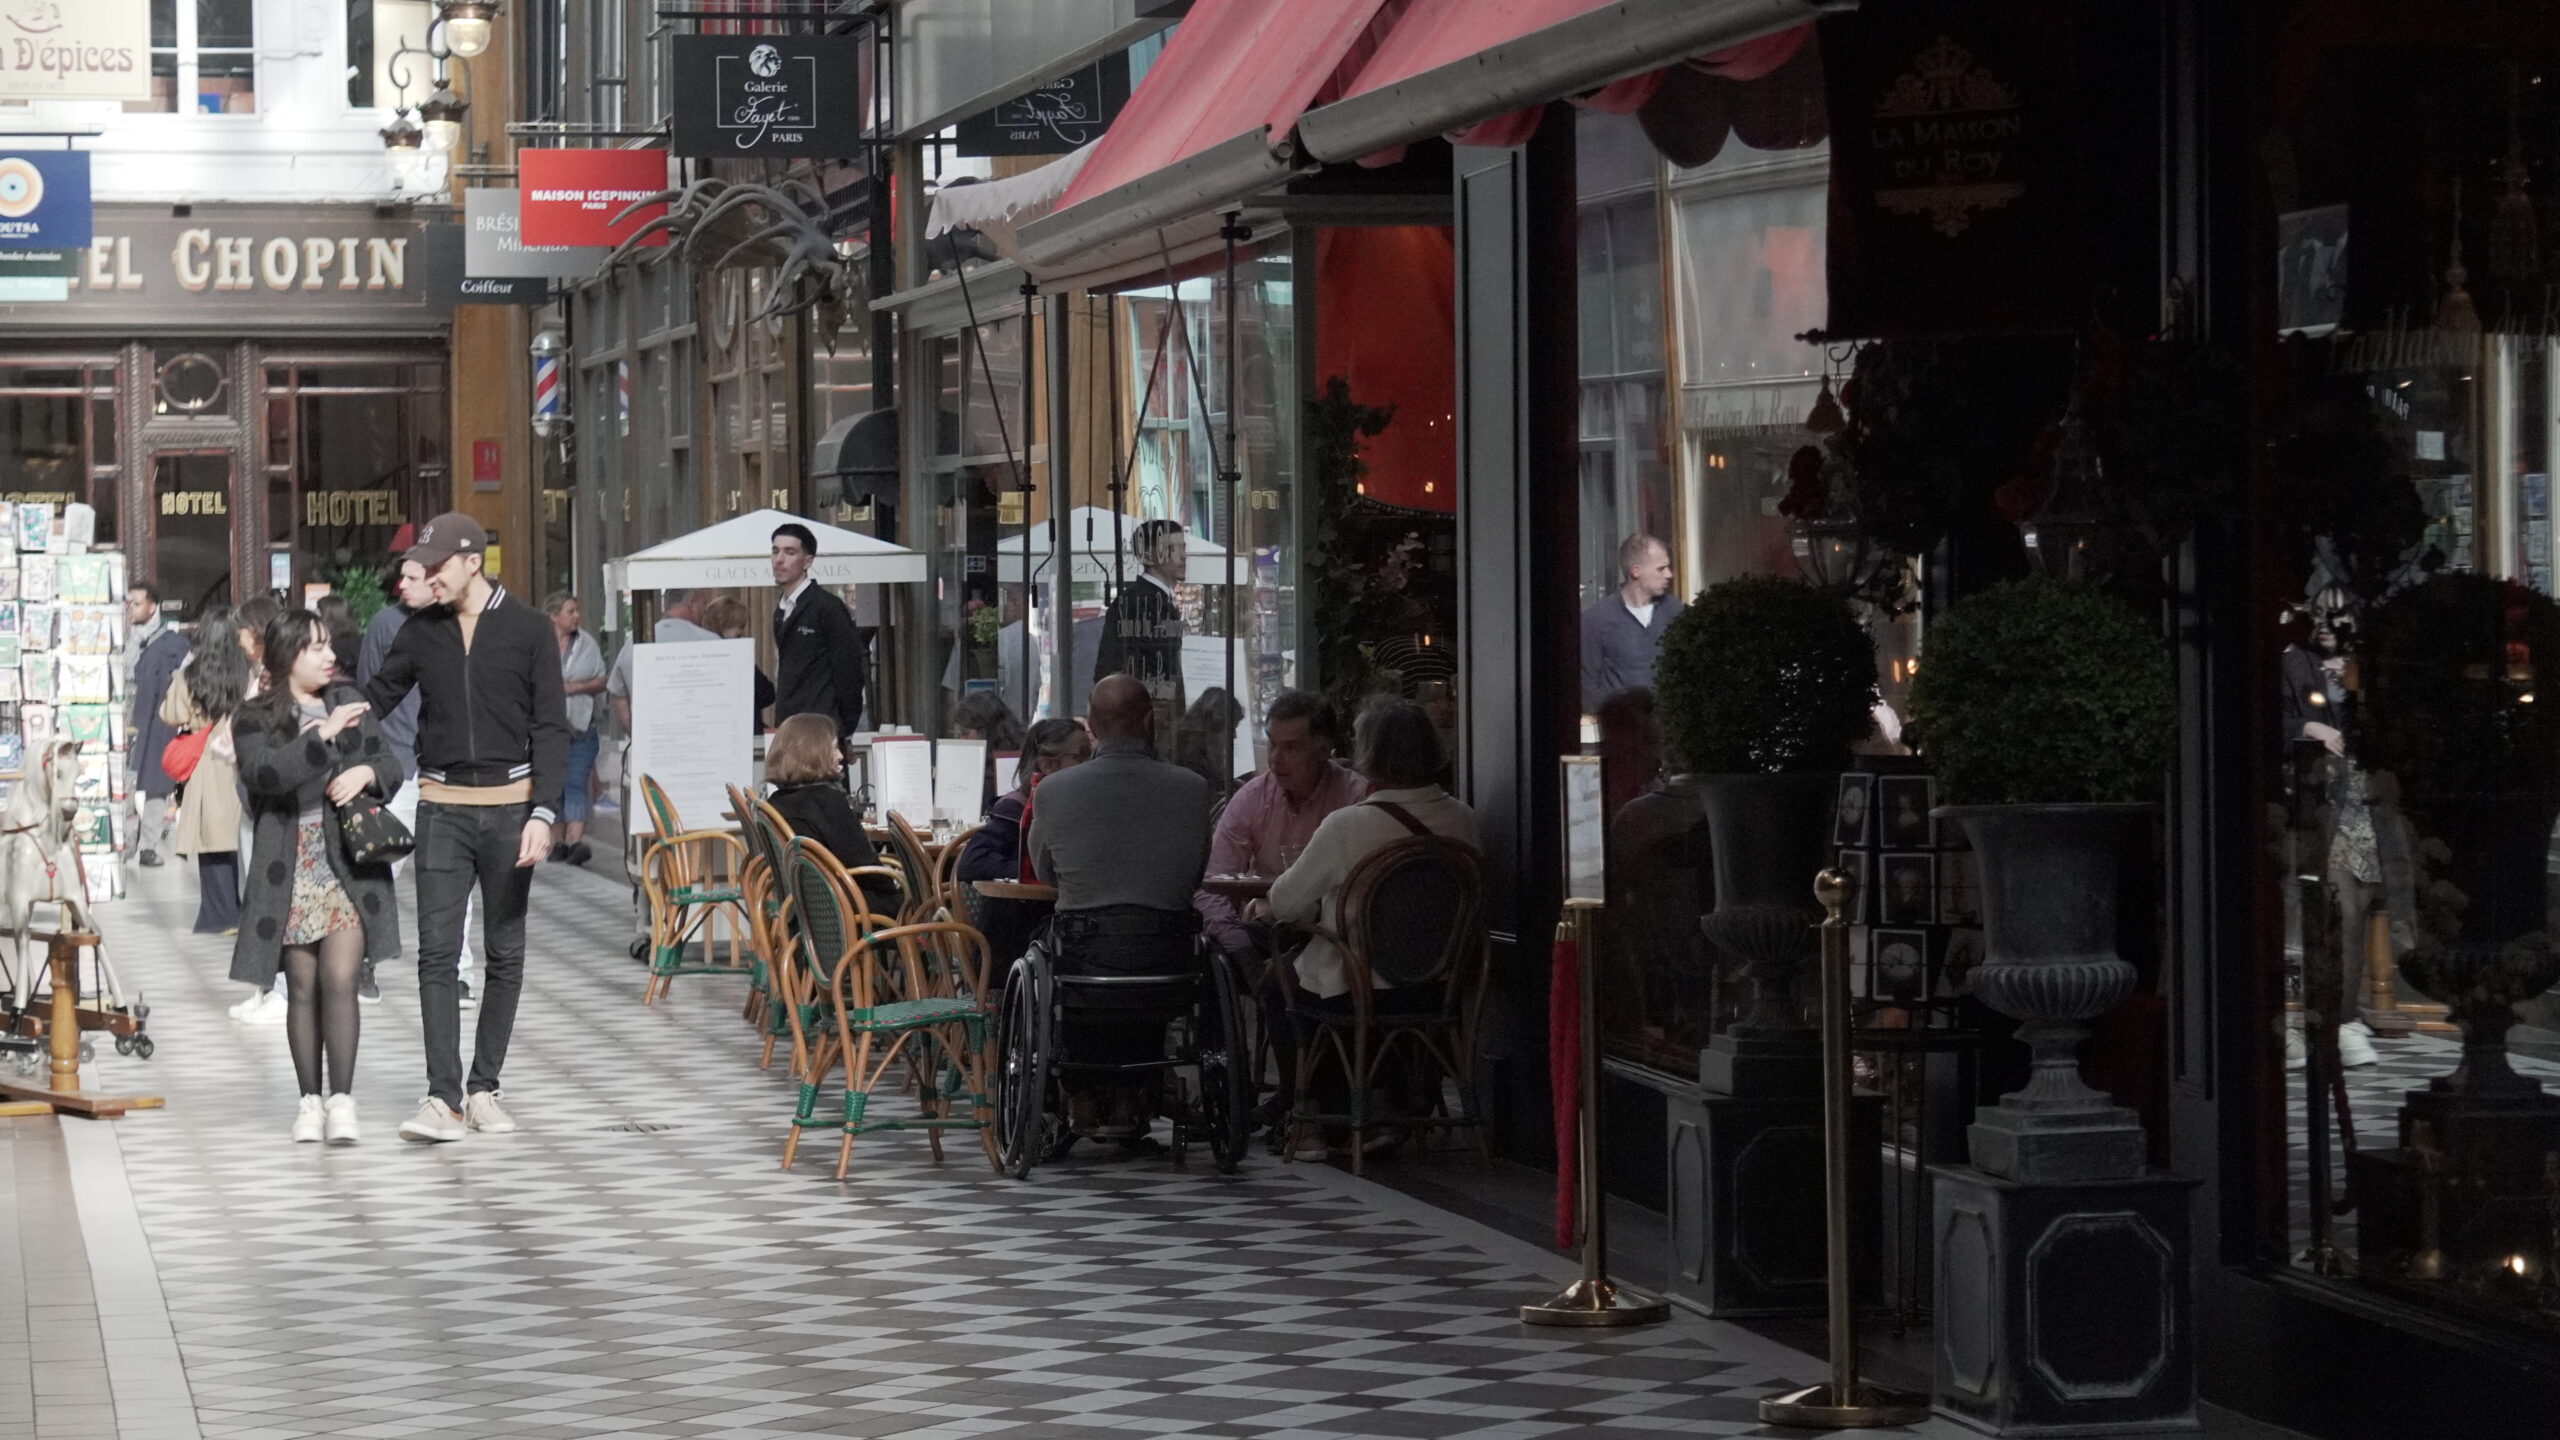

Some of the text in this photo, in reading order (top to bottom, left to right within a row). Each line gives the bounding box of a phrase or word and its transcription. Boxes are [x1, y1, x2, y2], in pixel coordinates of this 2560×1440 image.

[13, 38, 133, 80] D'épices
[744, 81, 788, 93] Galerie
[772, 133, 803, 143] PARIS
[531, 190, 583, 201] MAISON
[582, 201, 607, 210] PARIS
[172, 228, 407, 292] CHOPIN
[460, 279, 513, 294] Coiffeur
[161, 491, 227, 515] HOTEL
[306, 489, 407, 527] HOTEL
[705, 566, 758, 581] GLACES
